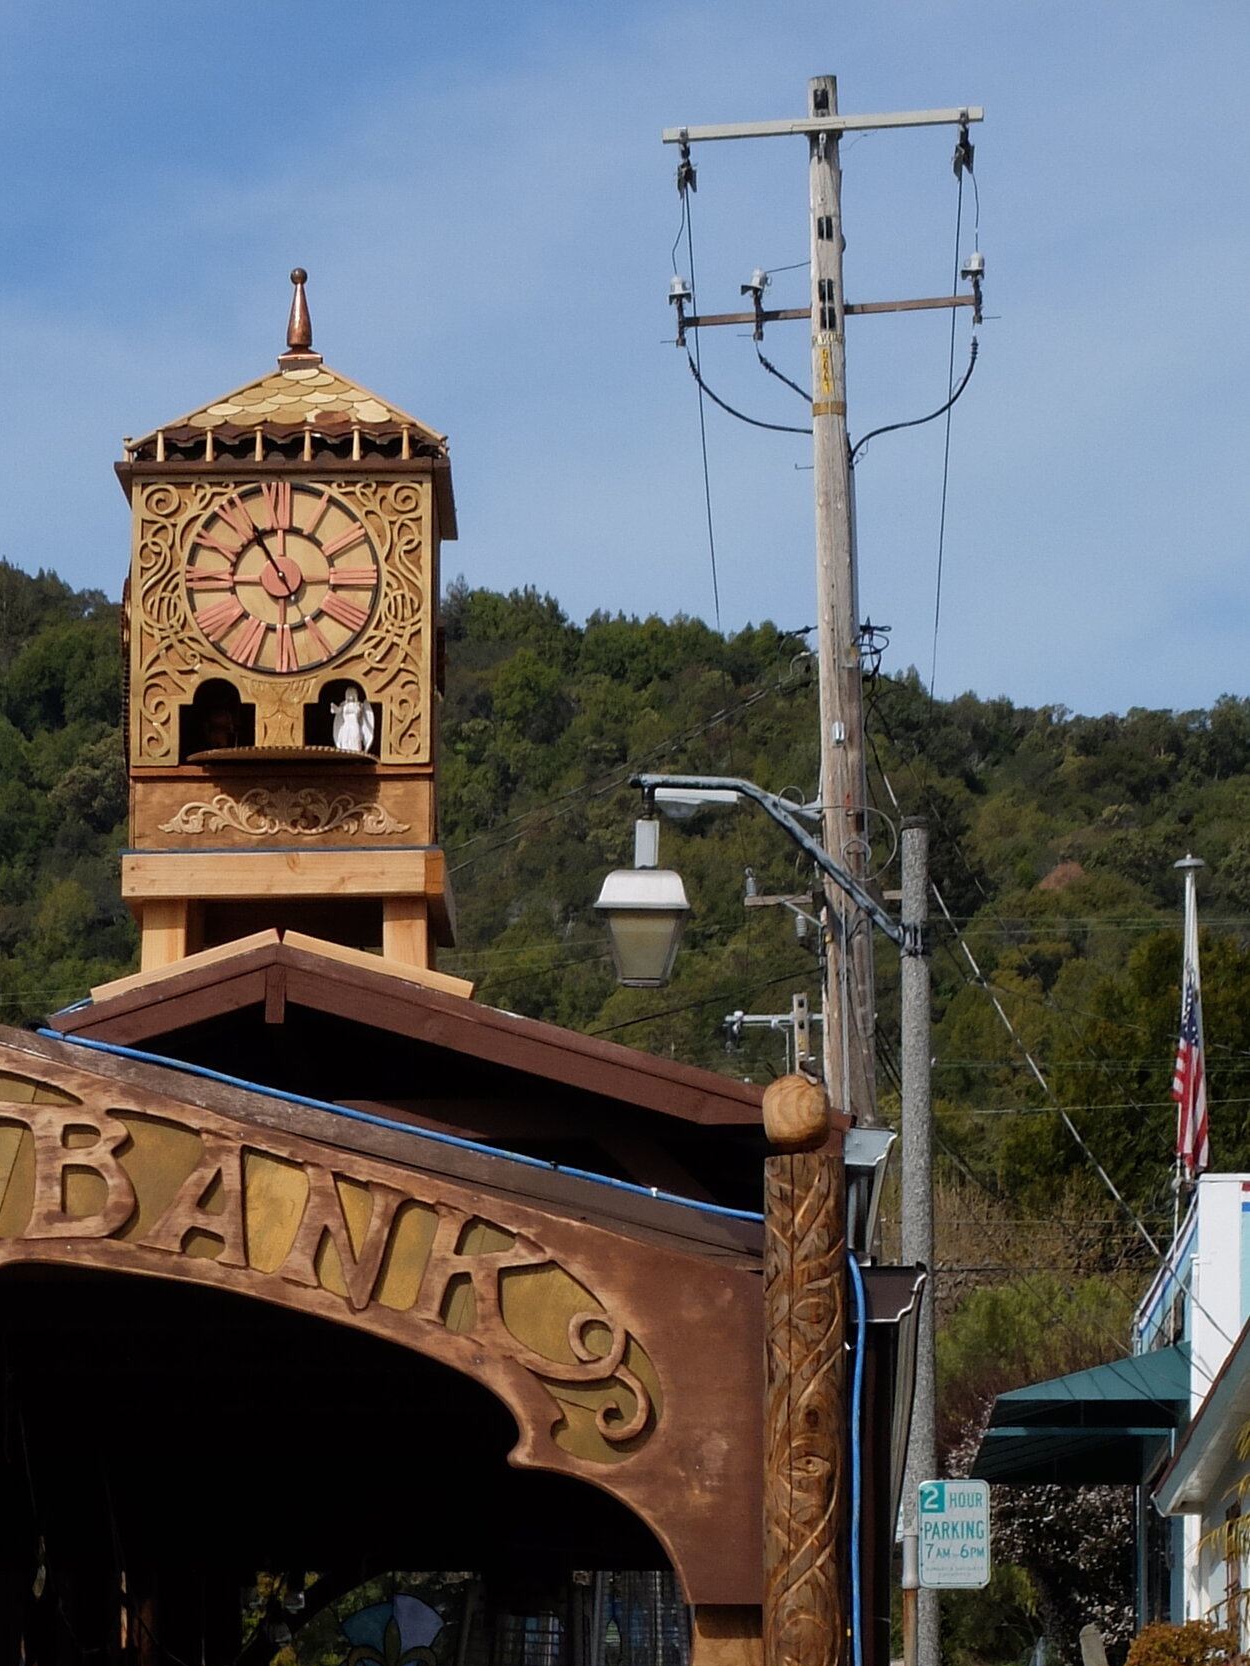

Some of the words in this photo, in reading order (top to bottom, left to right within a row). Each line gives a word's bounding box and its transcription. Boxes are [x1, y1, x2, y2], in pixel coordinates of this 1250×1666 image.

[261, 482, 291, 530] XII
[303, 491, 330, 535] I
[321, 520, 366, 557] II
[329, 563, 378, 585] III
[24, 1104, 552, 1348] BANK
[924, 1486, 939, 1509] 2
[950, 1492, 983, 1507] HOUR
[924, 1521, 985, 1540] PARKING
